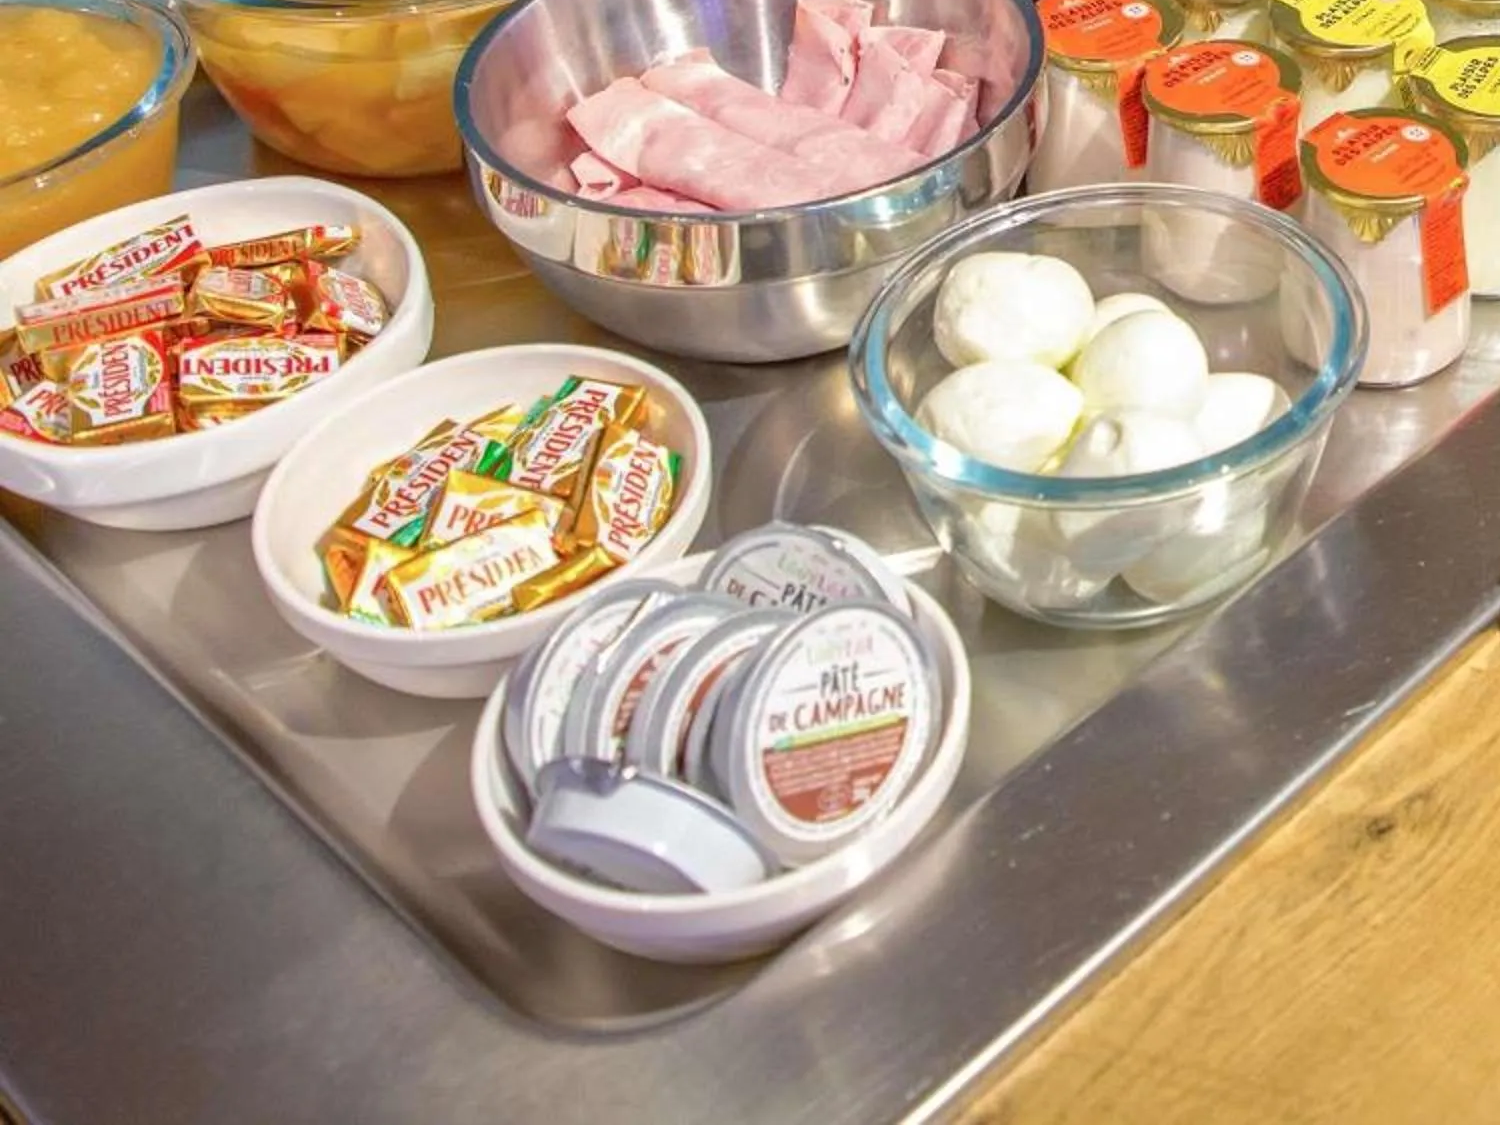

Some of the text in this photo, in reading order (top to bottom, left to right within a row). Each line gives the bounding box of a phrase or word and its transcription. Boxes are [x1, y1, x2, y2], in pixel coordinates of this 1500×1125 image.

[99, 342, 133, 419] PRÉSIDEN
[769, 682, 906, 732] DE CAMPAGNE
